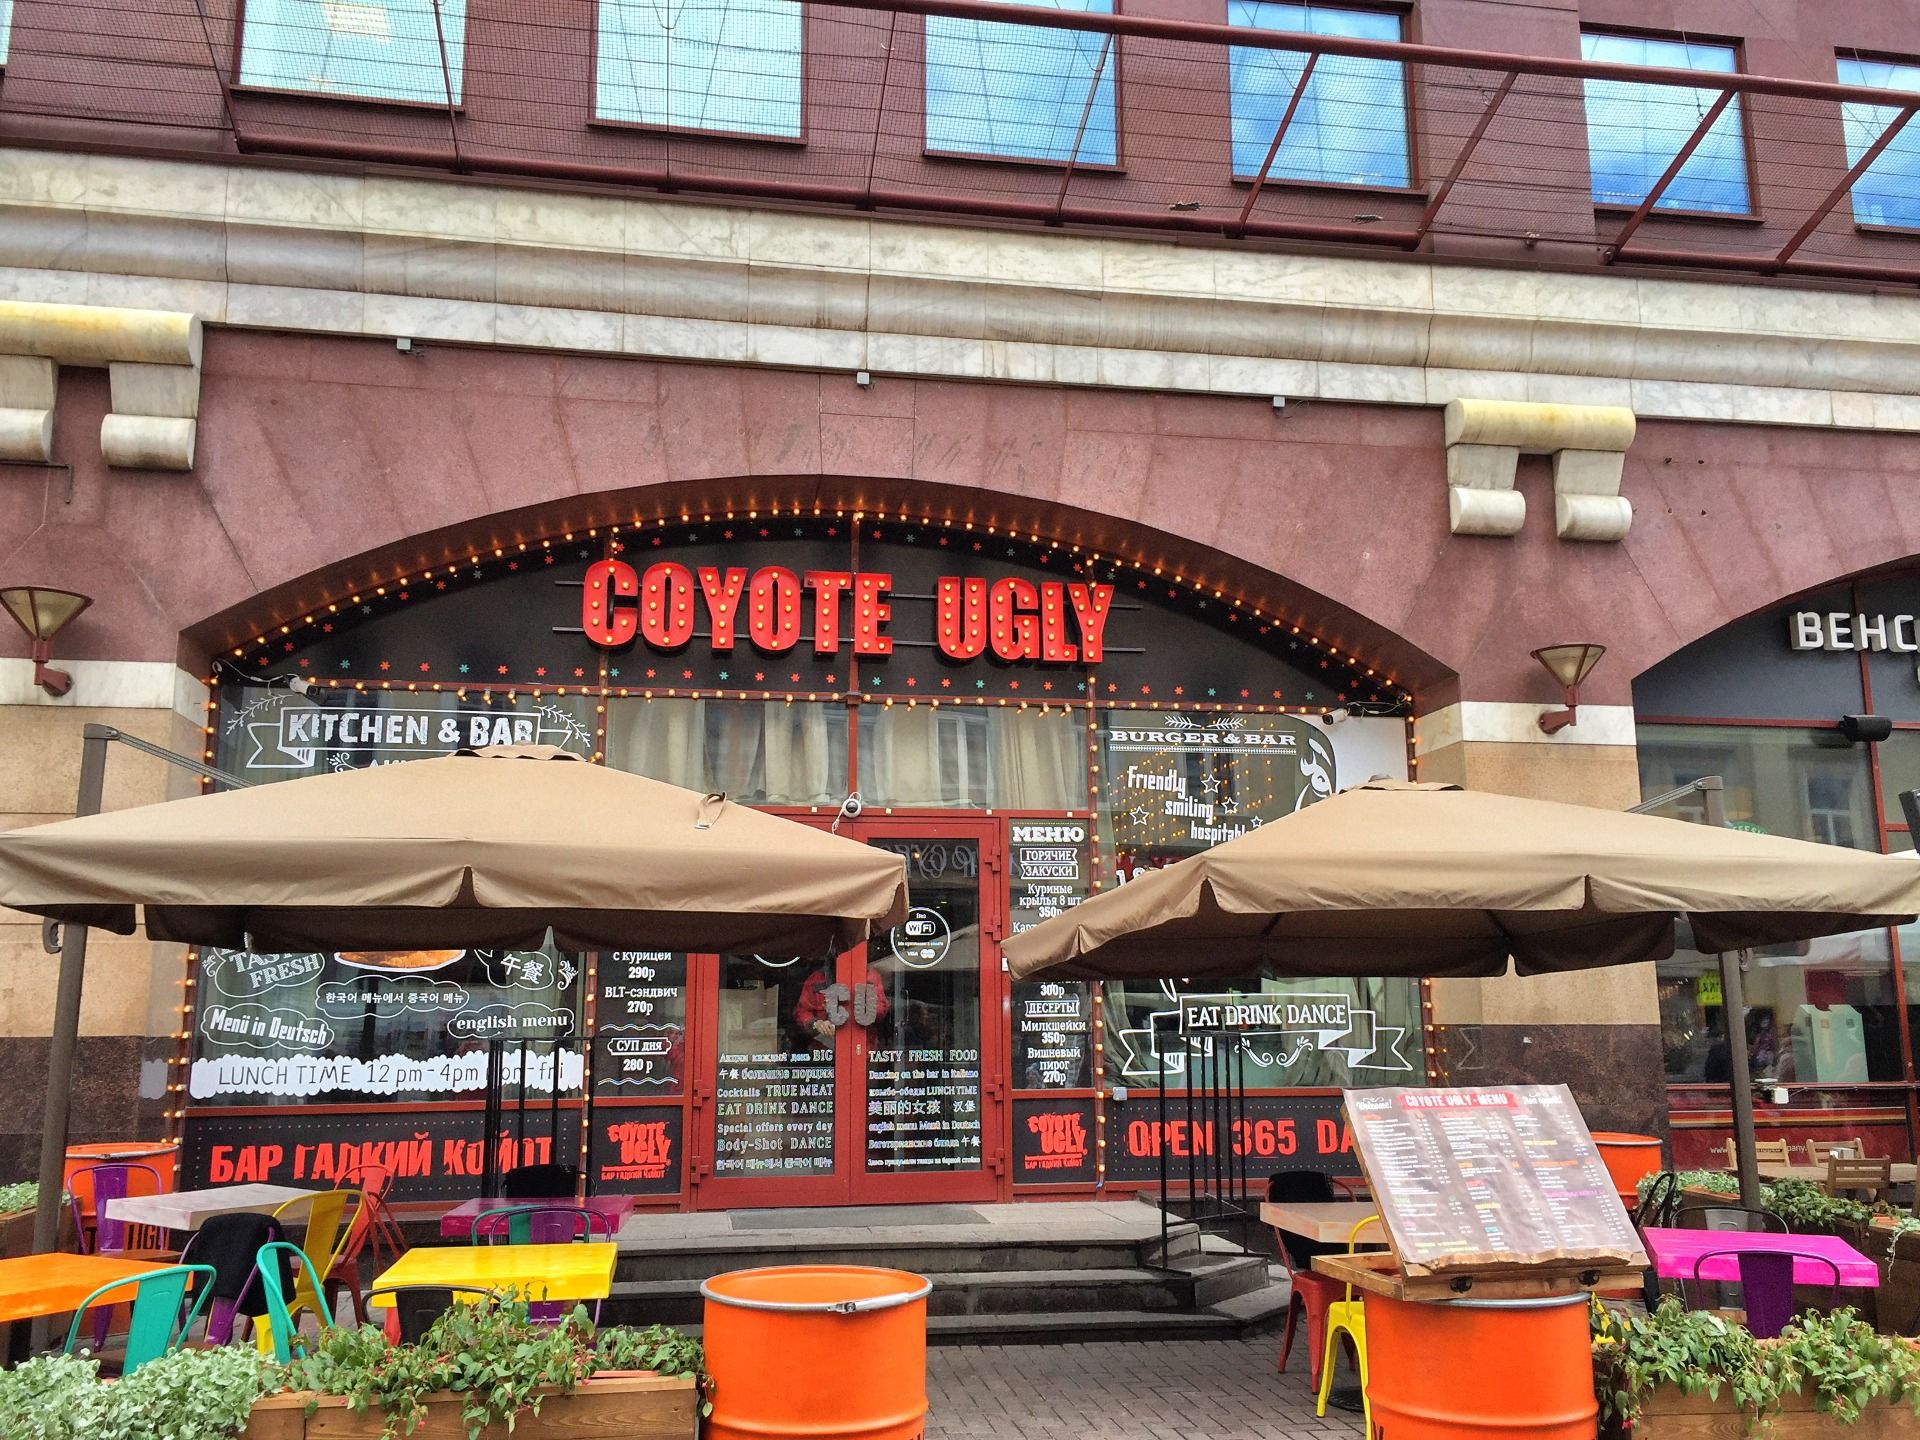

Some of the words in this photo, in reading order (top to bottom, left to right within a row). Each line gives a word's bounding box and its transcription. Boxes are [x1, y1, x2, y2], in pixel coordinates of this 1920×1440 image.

[582, 560, 893, 655] COYOTE
[937, 575, 1115, 664] UGLY
[1790, 611, 1920, 653] ВЕНС
[288, 712, 428, 745] KITCHEN
[437, 718, 461, 744] &
[469, 716, 534, 747] BAR
[1110, 730, 1218, 744] BURGER
[1224, 732, 1241, 744] &
[1244, 734, 1297, 746] BAR
[1127, 765, 1187, 799] Friendly
[1165, 796, 1214, 825] smiling
[1012, 826, 1085, 842] МЕНЮ
[1190, 820, 1250, 847] hospitabl
[1026, 850, 1072, 861] ГОРЯЧИЕ
[1025, 865, 1073, 877] ЗАКУСКИ
[1027, 883, 1073, 897] Куриные
[1019, 897, 1057, 908] крылья
[1060, 896, 1066, 906] 8
[908, 923, 932, 933] WiFi
[612, 951, 620, 960] с
[248, 953, 321, 989] FRESH
[500, 953, 545, 985] 午餐
[628, 966, 656, 981] 290р
[325, 992, 358, 1004] 한국어
[361, 992, 404, 1004] 메뉴에서
[407, 992, 440, 1004] 중국어
[443, 992, 465, 1004] 메뉴
[605, 986, 678, 999] BLT-сэндвич
[627, 1000, 654, 1016] 270р
[818, 983, 877, 1026] CU
[1028, 1001, 1076, 1015] ДЕСЕРТЫ
[1186, 1006, 1221, 1027] EAT
[1225, 1004, 1283, 1025] DRINK
[1287, 1004, 1346, 1025] DANCE
[209, 1008, 251, 1034] Menü
[251, 1016, 267, 1037] in
[268, 1016, 328, 1045] Deutsch
[456, 1015, 517, 1032] english
[522, 1015, 568, 1028] menu
[1021, 1020, 1086, 1032] Милкшейки
[616, 1040, 640, 1051] СУП
[641, 1040, 663, 1052] дня
[1041, 1032, 1066, 1045] 350р
[812, 1049, 833, 1061] BIG
[868, 1051, 903, 1062] TASTY
[908, 1050, 944, 1061] FRESH
[949, 1049, 978, 1061] FOOD
[1027, 1047, 1081, 1058] Вишневый
[623, 1059, 644, 1071] 280
[1039, 1061, 1070, 1072] пирог
[218, 1065, 288, 1087] LUNCH
[297, 1064, 351, 1084] TIME
[912, 1069, 925, 1079] the
[1043, 1071, 1067, 1085] 270р
[717, 1087, 761, 1098] Cocktails
[765, 1084, 798, 1096] TRUE
[799, 1083, 834, 1096] MEAT
[926, 1086, 955, 1096] LUNCH
[956, 1085, 978, 1095] TIME
[1404, 1095, 1445, 1107] COYOTE
[1444, 1094, 1473, 1106] UGLY
[1476, 1093, 1508, 1105] MENU
[717, 1103, 742, 1115] EAT
[745, 1102, 787, 1115] DRINK
[791, 1101, 834, 1114] DANCE
[868, 1100, 941, 1116] 美丽的女孩
[952, 1100, 976, 1113] 汉堡
[717, 1122, 753, 1135] Special
[755, 1121, 784, 1132] offers
[786, 1122, 814, 1134] every
[815, 1121, 833, 1133] day
[1027, 1112, 1081, 1133] COYOTE
[607, 1121, 666, 1142] COYOTE
[1127, 1119, 1214, 1157] OPEN
[1231, 1119, 1297, 1157] 365
[717, 1137, 784, 1154] Body-Shot
[790, 1136, 832, 1149] DANCE
[1041, 1129, 1086, 1153] UGLY
[210, 1144, 283, 1183] БАР
[293, 1131, 433, 1184] ГАДКИЙ
[621, 1138, 671, 1164] UGLY
